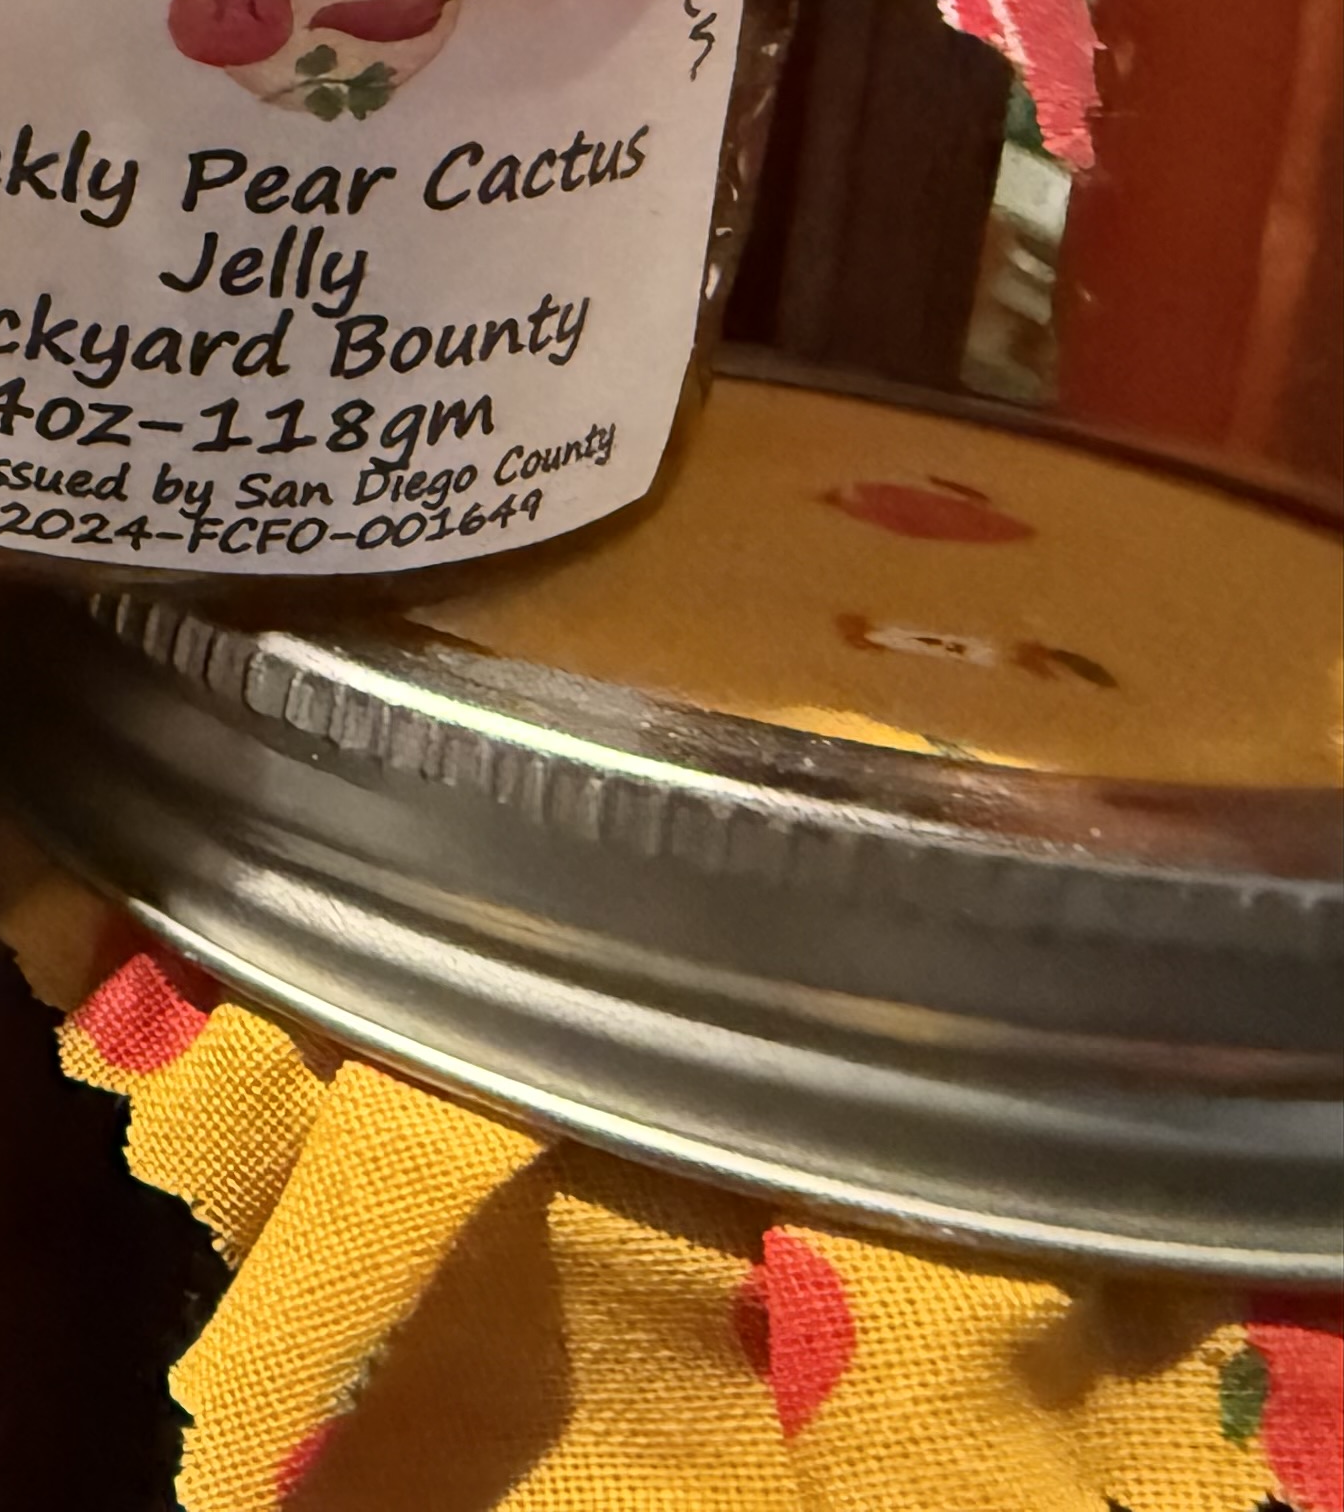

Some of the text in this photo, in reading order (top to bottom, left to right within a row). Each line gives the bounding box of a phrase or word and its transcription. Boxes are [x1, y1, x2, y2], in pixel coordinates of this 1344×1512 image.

[181, 145, 395, 218] Pear
[423, 125, 648, 213] Cactus
[158, 225, 367, 319] Jelly
[332, 295, 591, 382] Bounty
[156, 469, 212, 516] by
[238, 471, 332, 511] San
[357, 462, 477, 509] Diego
[495, 422, 617, 487] County
